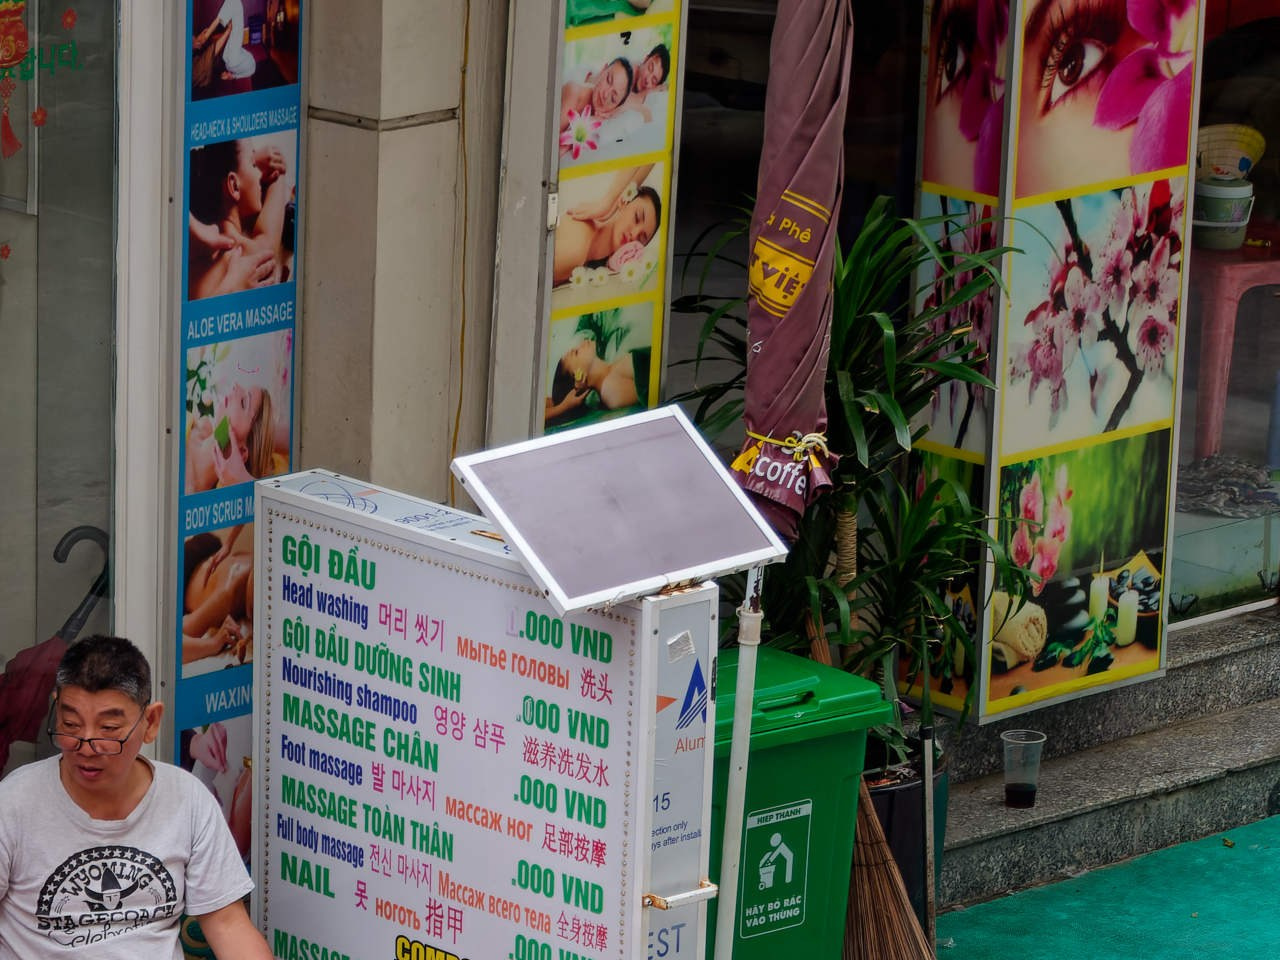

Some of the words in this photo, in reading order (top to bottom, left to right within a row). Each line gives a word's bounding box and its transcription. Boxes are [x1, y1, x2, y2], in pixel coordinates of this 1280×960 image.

[232, 111, 268, 134] SHOULDERS
[779, 217, 812, 243] Phê
[188, 316, 214, 340] ALOE
[217, 311, 243, 334] VERA
[245, 301, 293, 329] MASSAGE
[185, 505, 211, 530] BODY
[213, 498, 243, 525] SCRUB
[282, 534, 320, 577] GỘI
[328, 546, 376, 590] ĐẦU
[282, 574, 313, 610] Head
[316, 590, 369, 630] washing
[379, 603, 407, 640] 머리
[414, 613, 444, 653] 씻기
[570, 623, 613, 664] VND
[283, 616, 309, 658] GỘI
[315, 623, 349, 667] ĐẦU
[354, 641, 413, 688] DƯỠNG
[419, 662, 461, 703] SINH
[511, 652, 570, 690] головы
[282, 656, 352, 706] Nourishing
[356, 684, 417, 725] shampoo
[580, 667, 613, 705] 洗头
[283, 693, 376, 752] MASSAGE
[383, 727, 439, 773] CHÂN
[434, 705, 466, 741] 영양
[473, 718, 506, 754] 샴푸
[567, 708, 610, 749] VND
[281, 734, 306, 766] Foot
[309, 748, 363, 786] massage
[522, 735, 609, 787] 滋养洗发水
[372, 761, 385, 793] 발
[392, 769, 435, 811] 마사지
[564, 787, 607, 829] VND
[653, 792, 671, 812] 15
[277, 813, 293, 842] Full
[297, 820, 319, 854] body
[321, 831, 364, 868] massage
[281, 774, 357, 829] MASSAGE
[362, 803, 404, 846] TOÀN
[410, 820, 454, 863] THÂN
[506, 816, 533, 843] ног
[673, 820, 688, 831] only
[542, 822, 607, 868] 足部按摩
[663, 836, 679, 846] after
[281, 851, 335, 899] NAIL
[369, 844, 392, 878] 전신
[397, 854, 432, 893] 마사지
[488, 895, 520, 924] всего
[524, 906, 551, 935] тела
[562, 873, 604, 915] VND
[425, 897, 463, 945] 指甲
[556, 910, 608, 953] 全身按摩
